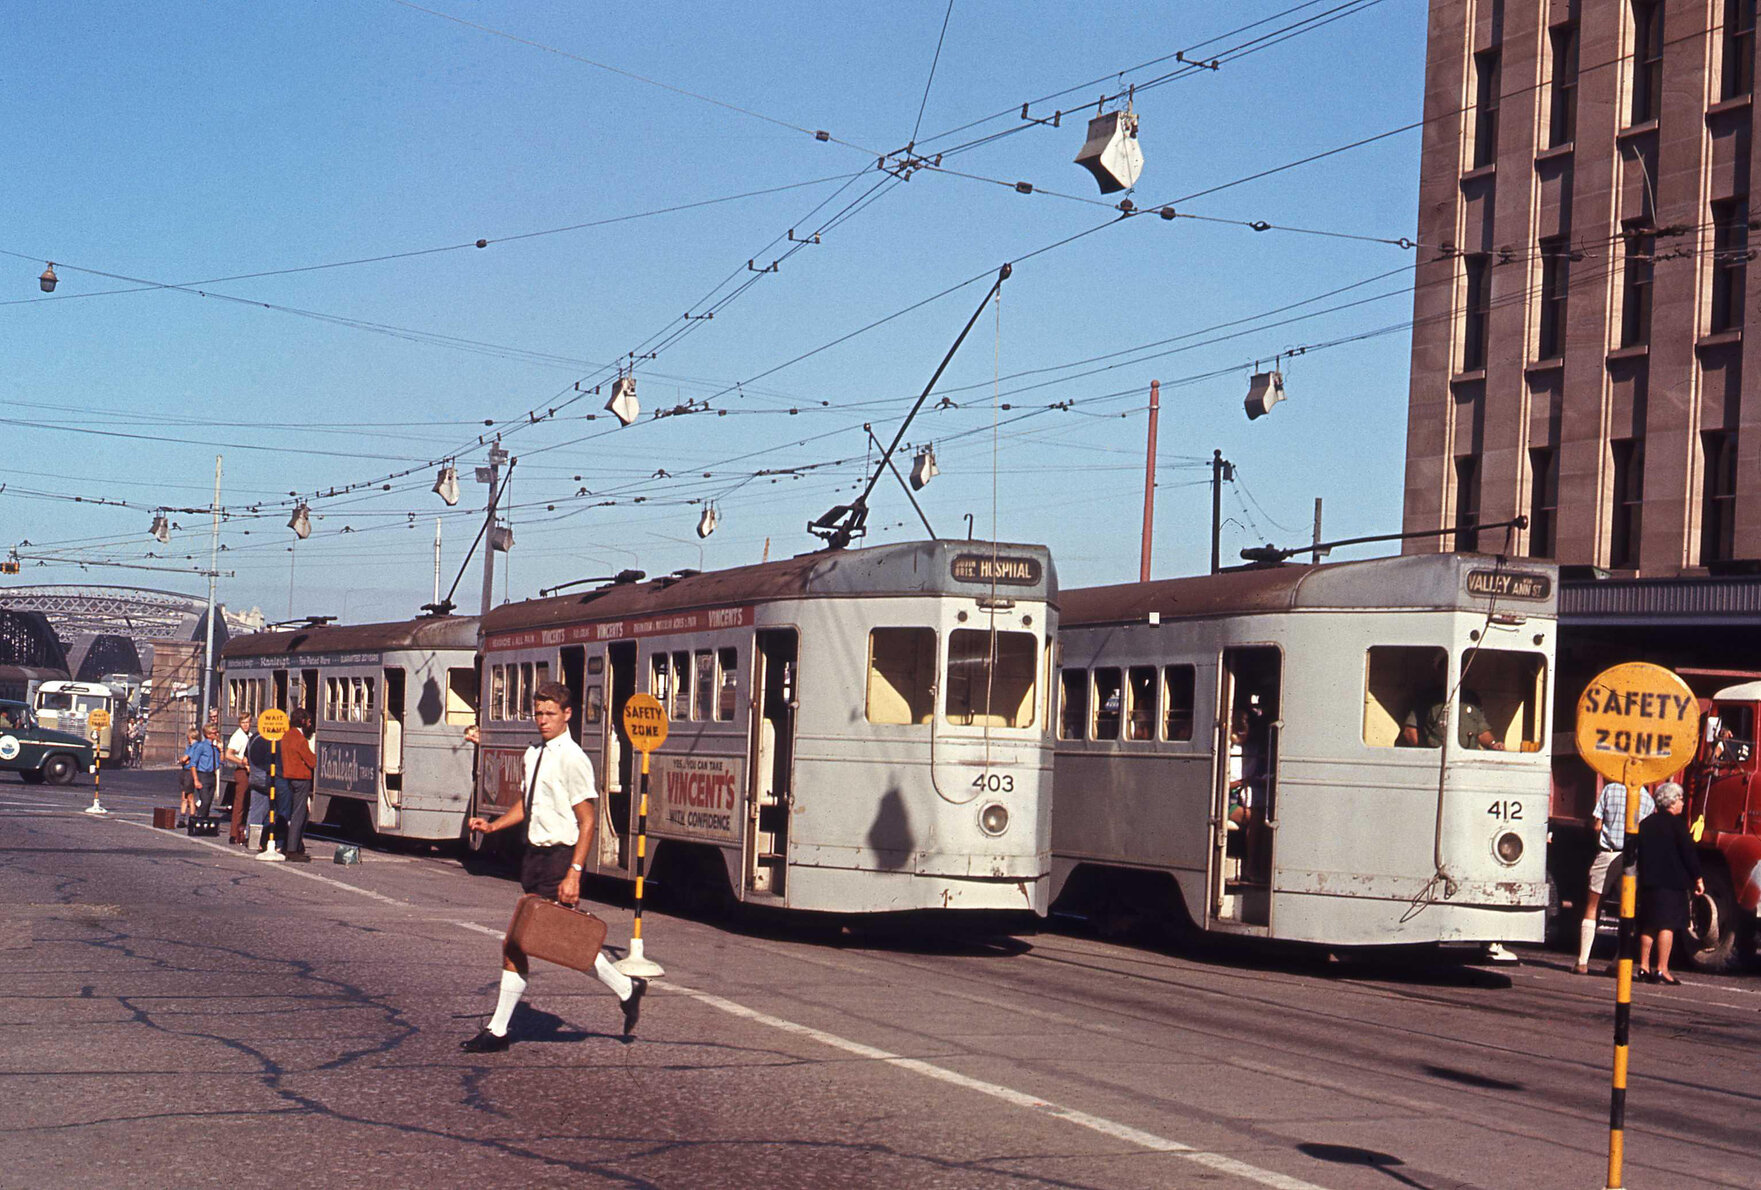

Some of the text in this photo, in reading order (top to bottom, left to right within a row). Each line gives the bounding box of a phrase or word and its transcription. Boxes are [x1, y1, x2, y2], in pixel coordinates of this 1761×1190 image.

[1512, 582, 1531, 596] ANN
[625, 705, 662, 720] SAFETY
[1585, 688, 1691, 721] SAFETY
[631, 724, 659, 737] ZONE
[1595, 728, 1673, 756] ZONE
[697, 760, 707, 770] CAN
[709, 761, 723, 771] TAKE
[667, 769, 735, 811] VINCENT'S
[972, 773, 1014, 792] 403
[1487, 800, 1523, 820] 412
[669, 809, 730, 831] WITH CONFIDENCE
